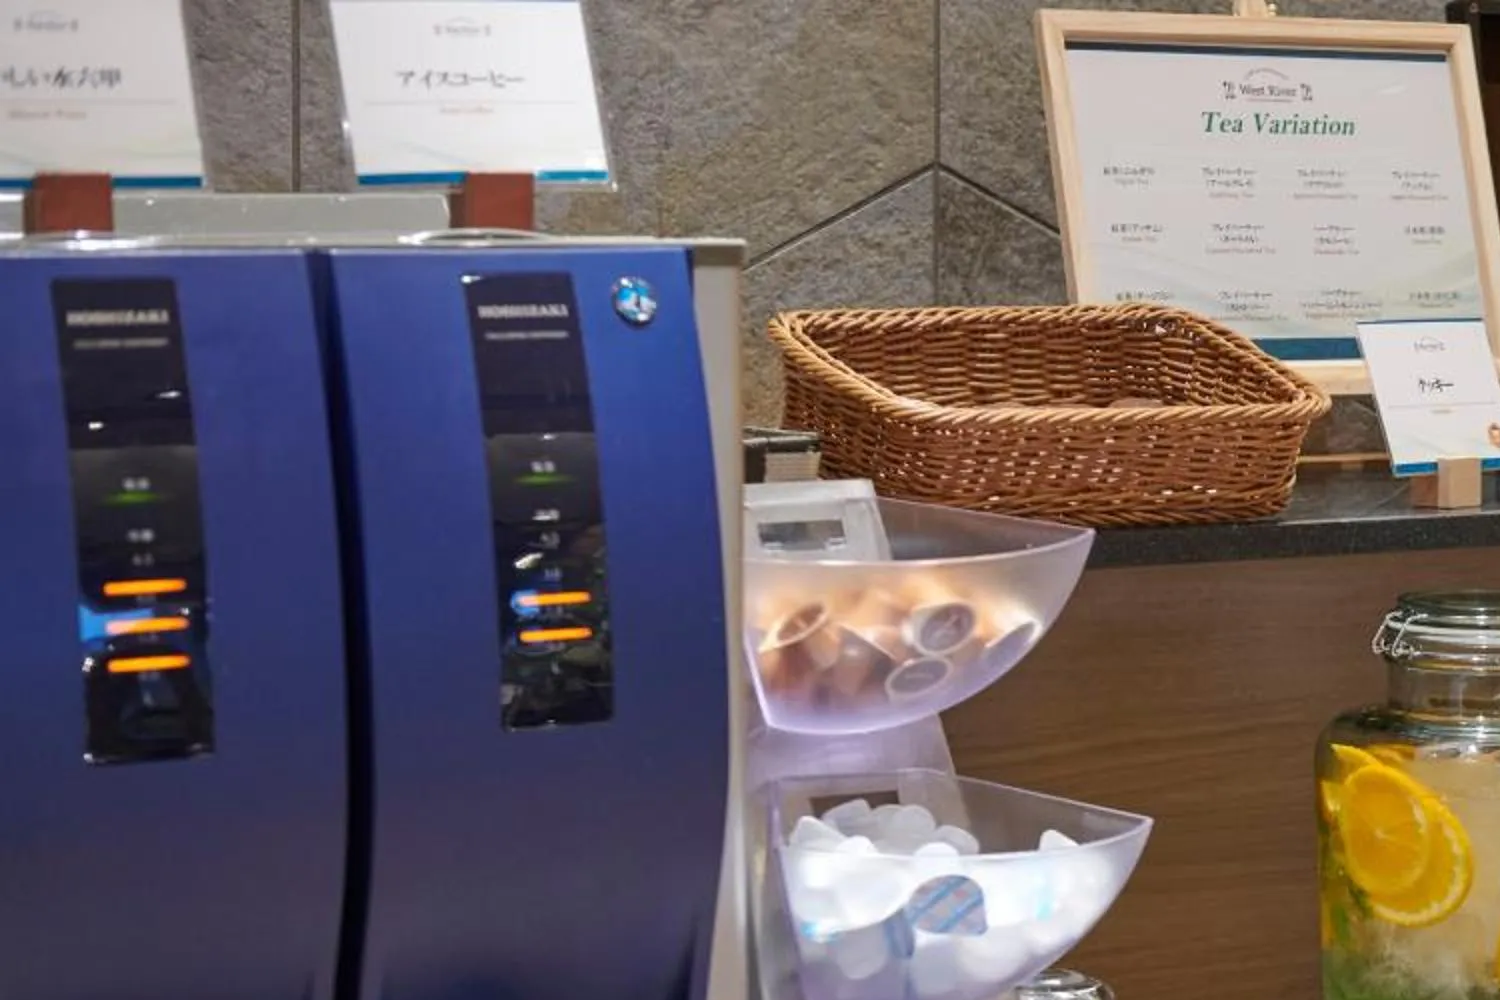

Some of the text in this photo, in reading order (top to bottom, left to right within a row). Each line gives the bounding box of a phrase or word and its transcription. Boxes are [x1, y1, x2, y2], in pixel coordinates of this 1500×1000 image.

[395, 69, 526, 90] アイスコーヒー
[1201, 111, 1356, 136] Tea Variation
